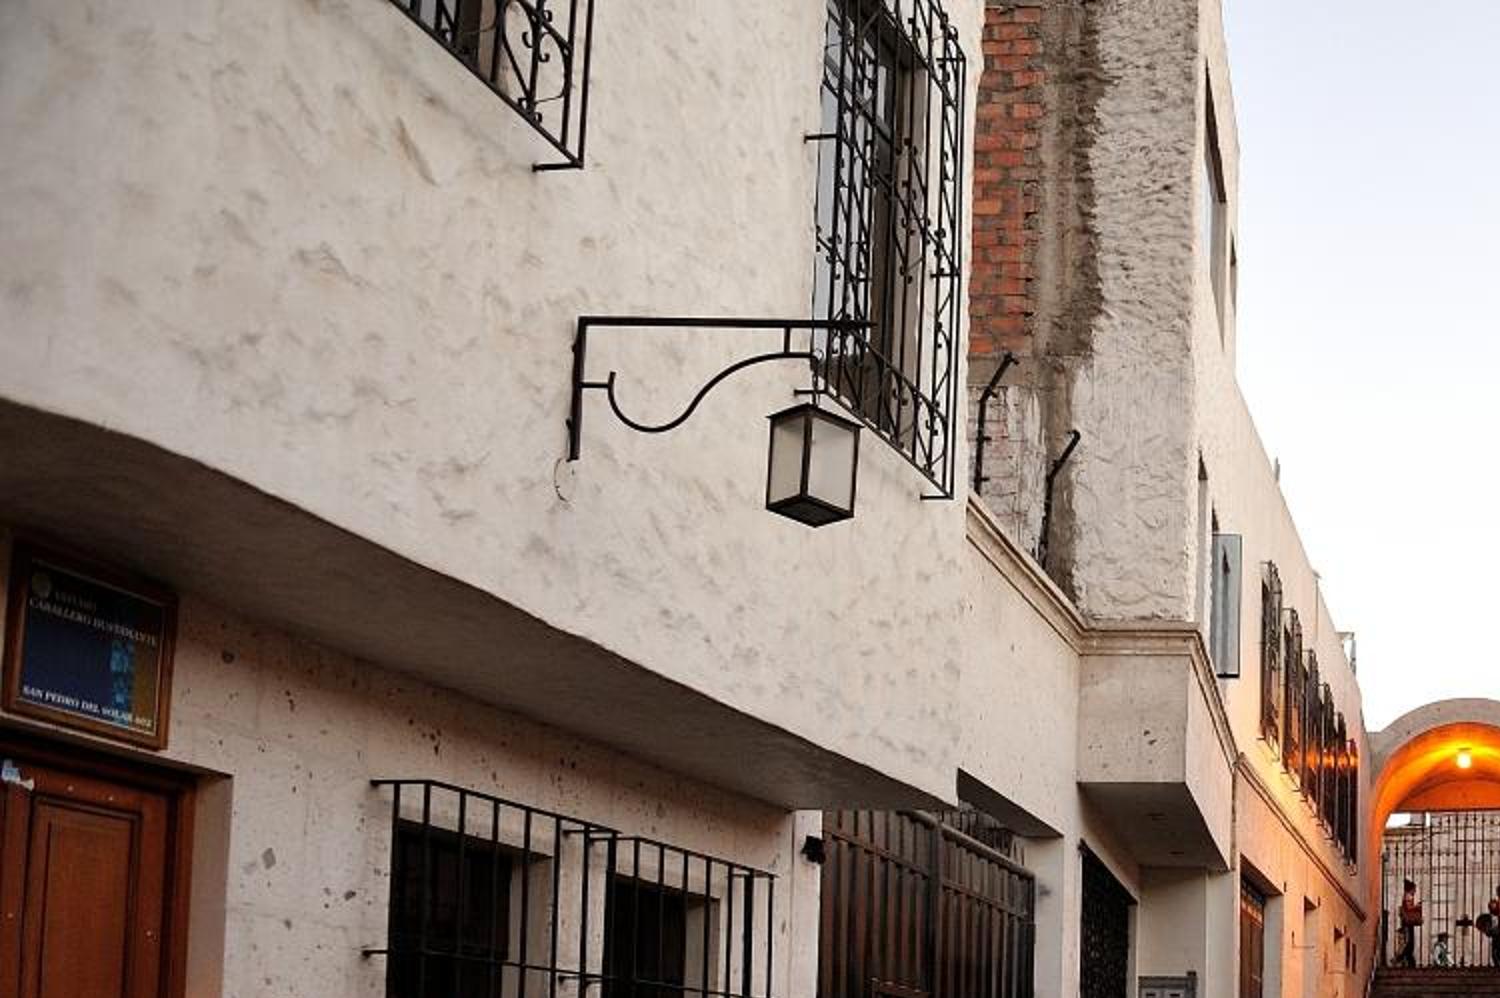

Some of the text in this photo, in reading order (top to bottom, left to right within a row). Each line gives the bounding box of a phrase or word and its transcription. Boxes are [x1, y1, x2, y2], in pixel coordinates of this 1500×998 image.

[28, 597, 92, 625] CABALLERO
[23, 685, 43, 699] SAN
[45, 691, 80, 708] PEDRO
[81, 700, 100, 714] DEL
